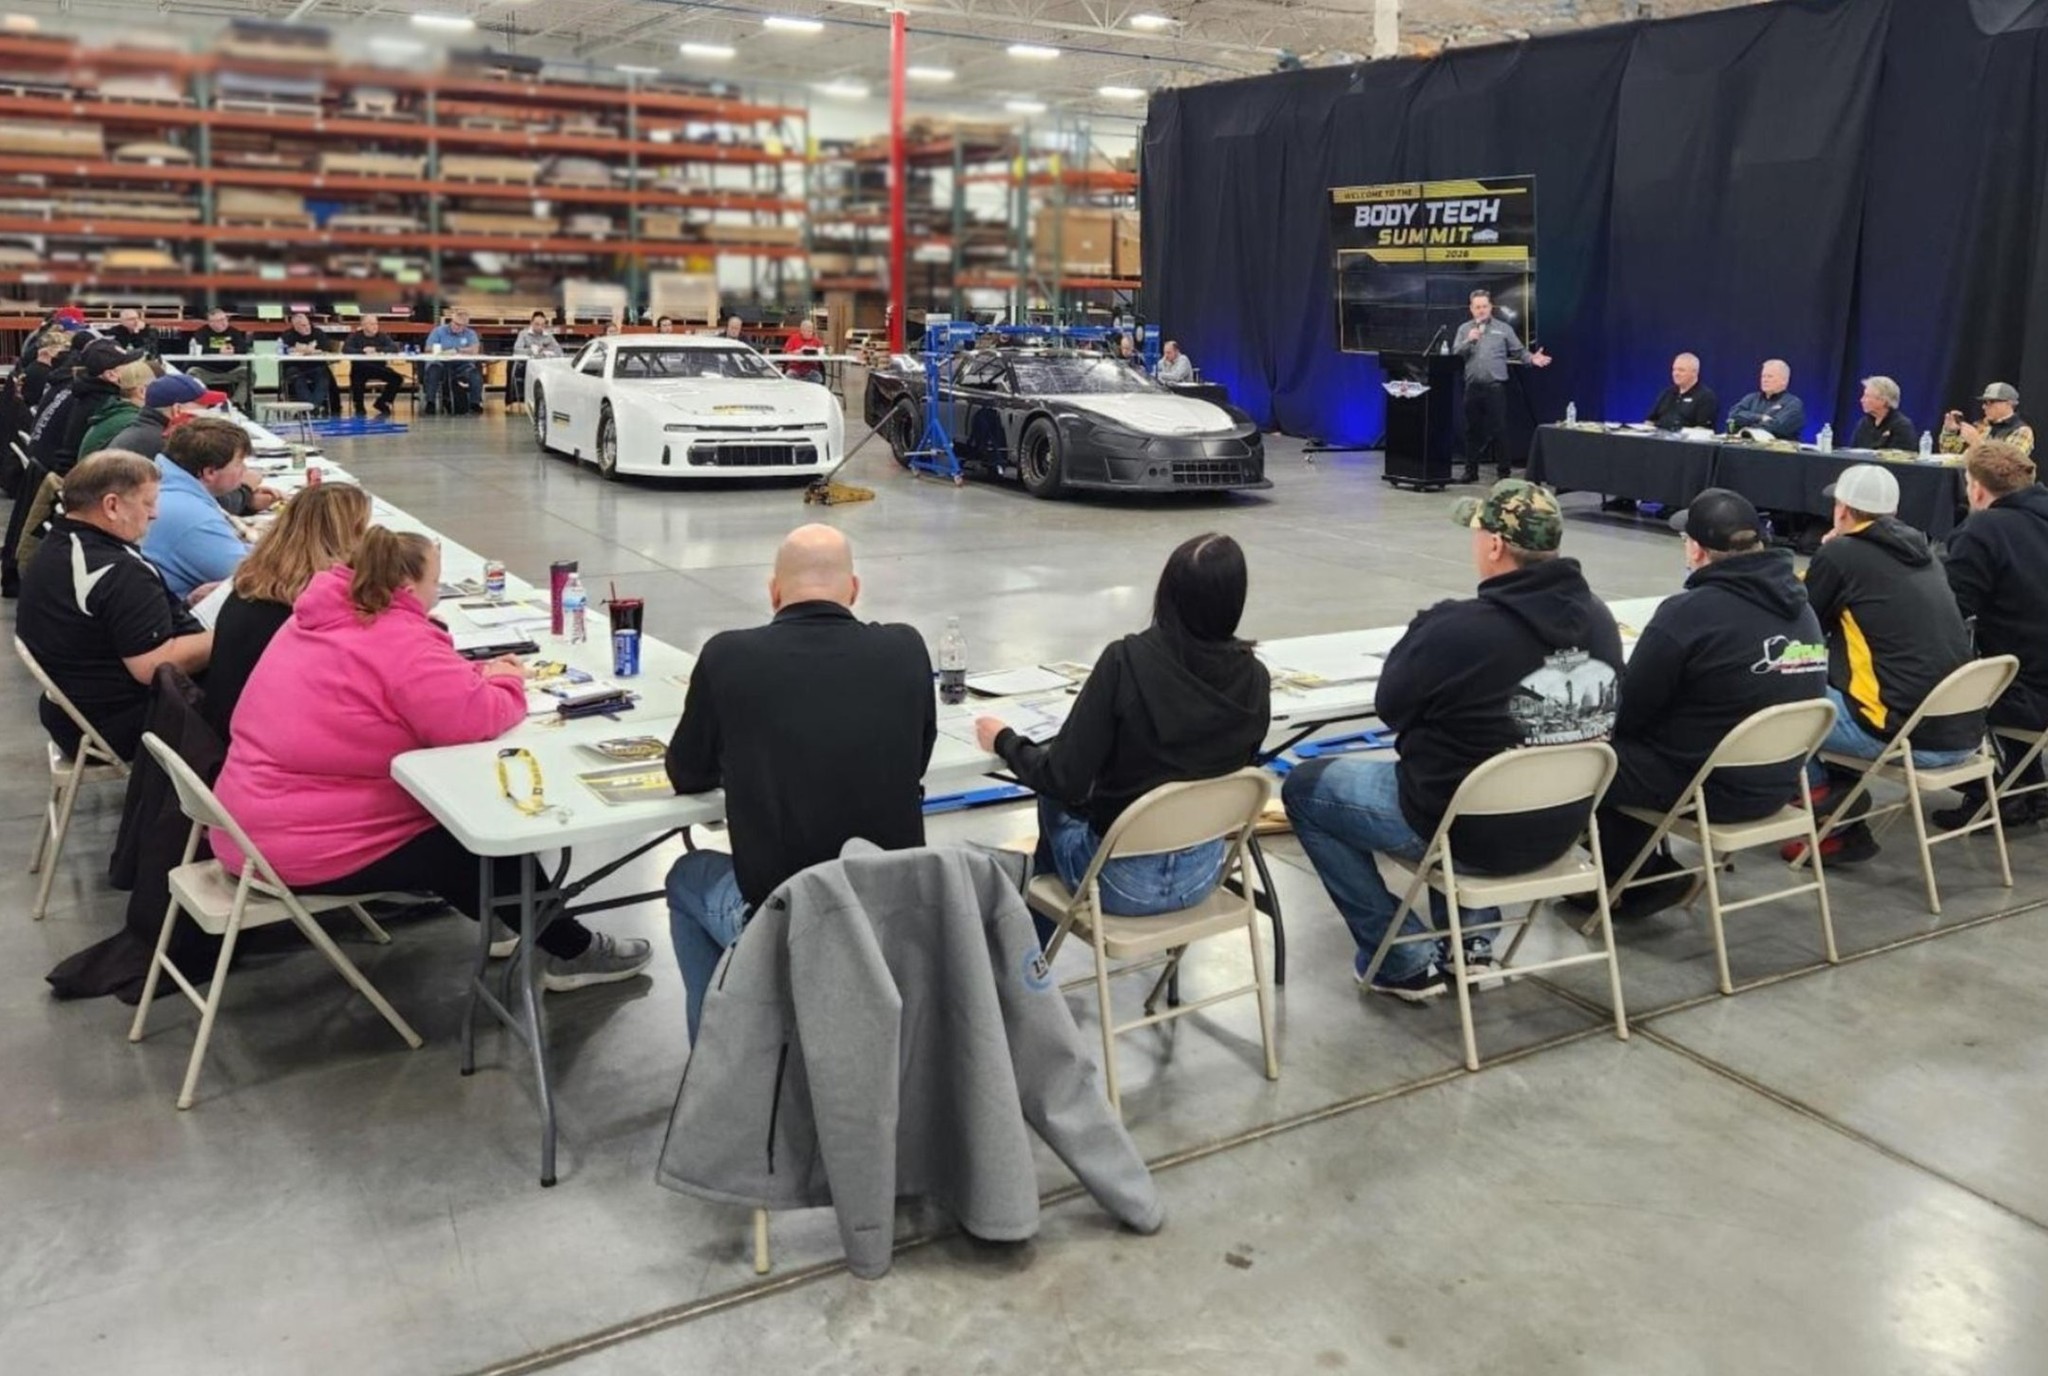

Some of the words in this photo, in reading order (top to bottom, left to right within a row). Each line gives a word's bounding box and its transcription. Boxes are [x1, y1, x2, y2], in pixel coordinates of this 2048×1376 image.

[1344, 189, 1383, 199] WELCOME
[1385, 189, 1395, 197] TO
[1397, 188, 1412, 196] THE
[1354, 204, 1419, 227] BODY
[1425, 199, 1500, 224] TECH
[1378, 226, 1473, 245] SUMMIT
